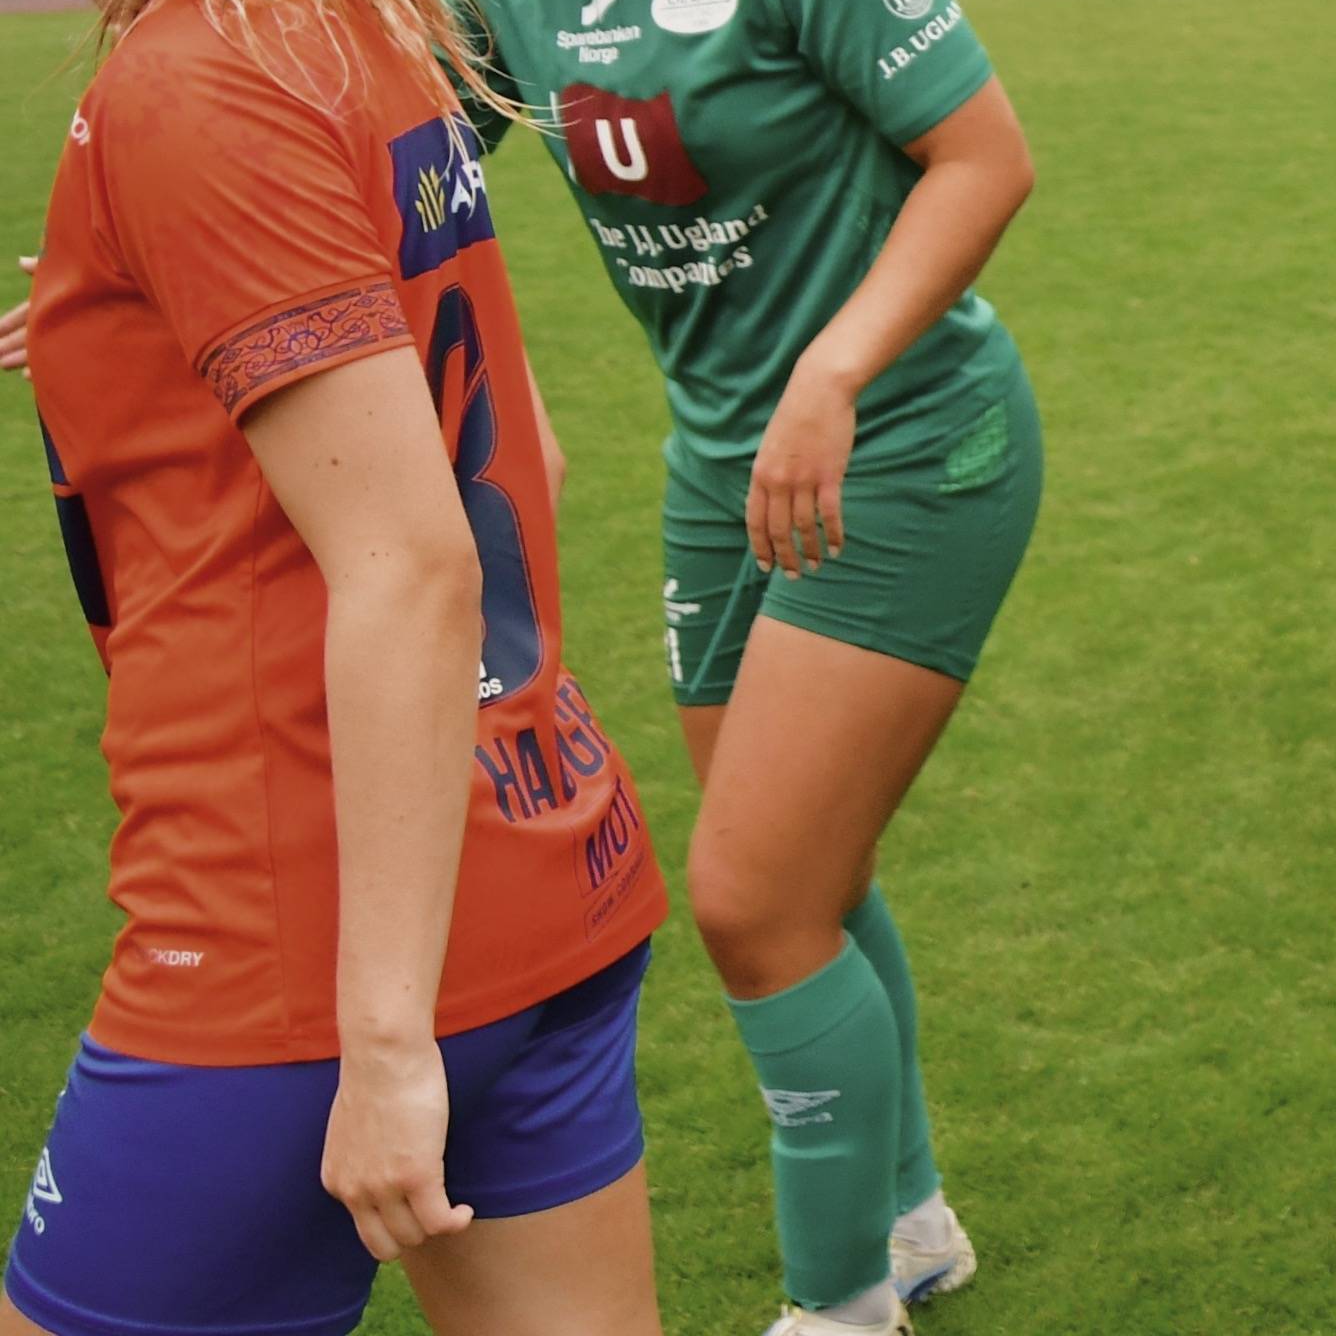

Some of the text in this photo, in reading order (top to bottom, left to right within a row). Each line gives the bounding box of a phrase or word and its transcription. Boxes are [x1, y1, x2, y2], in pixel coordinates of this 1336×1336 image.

[578, 46, 619, 65] Norge
[877, 46, 917, 80] J.B.
[596, 118, 648, 180] U
[658, 204, 768, 252] Ugland
[616, 246, 753, 293] ompanis
[586, 774, 640, 890] MOT
